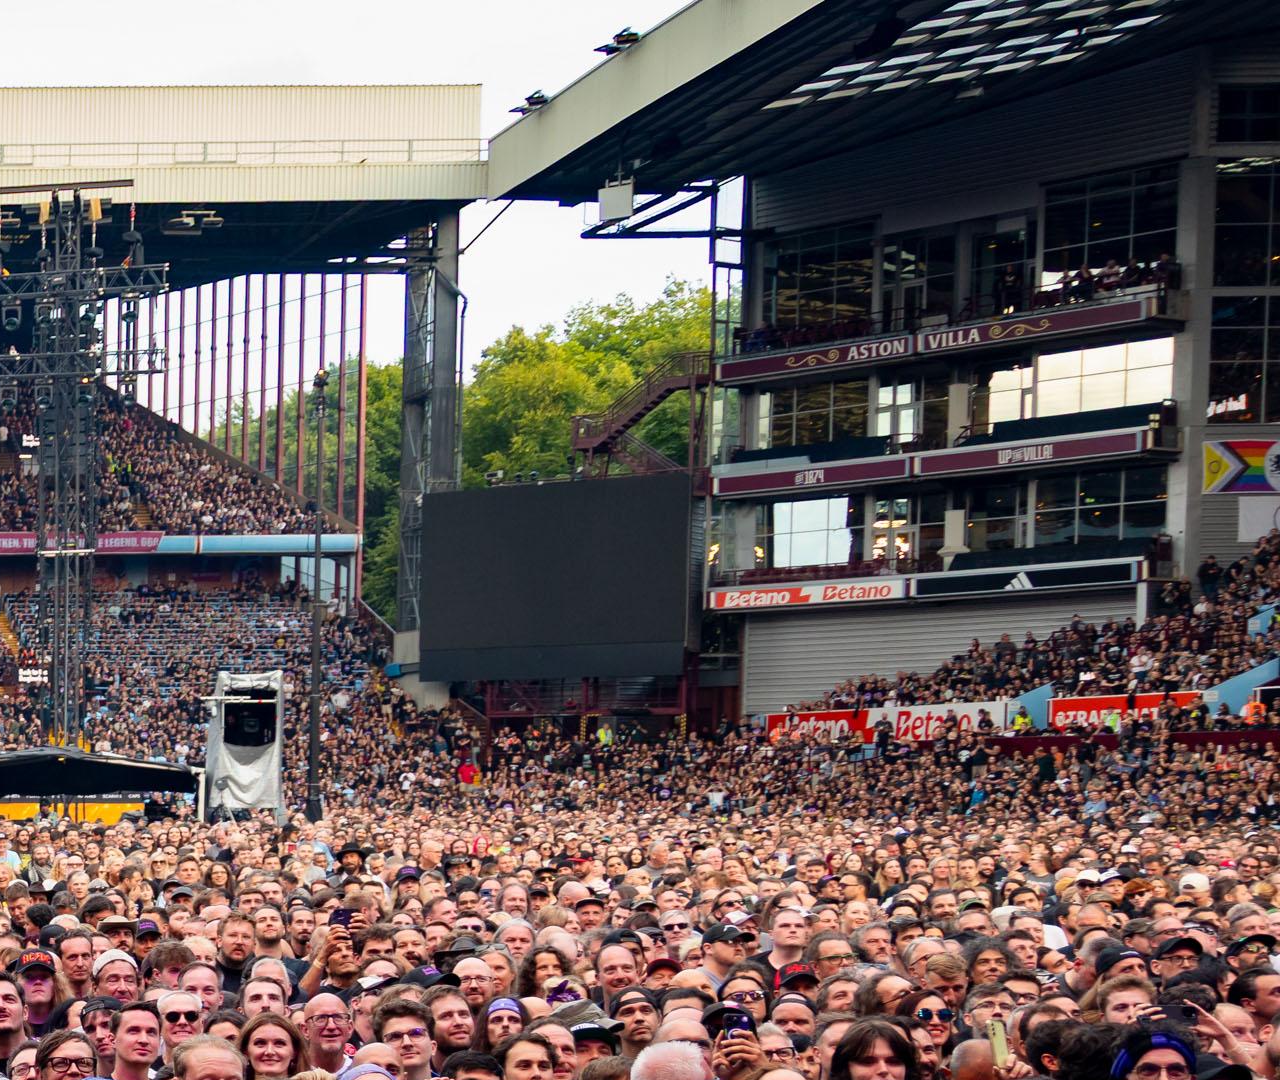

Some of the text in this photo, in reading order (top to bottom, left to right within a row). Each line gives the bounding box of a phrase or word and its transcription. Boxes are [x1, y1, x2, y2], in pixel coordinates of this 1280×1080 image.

[847, 328, 981, 361] ASTON VILLA
[997, 450, 1012, 465] UP
[1022, 444, 1054, 462] VILLA!
[804, 469, 825, 485] 1874
[20, 538, 37, 548] TH
[724, 584, 892, 608] Betano Betano
[895, 711, 972, 741] Betao
